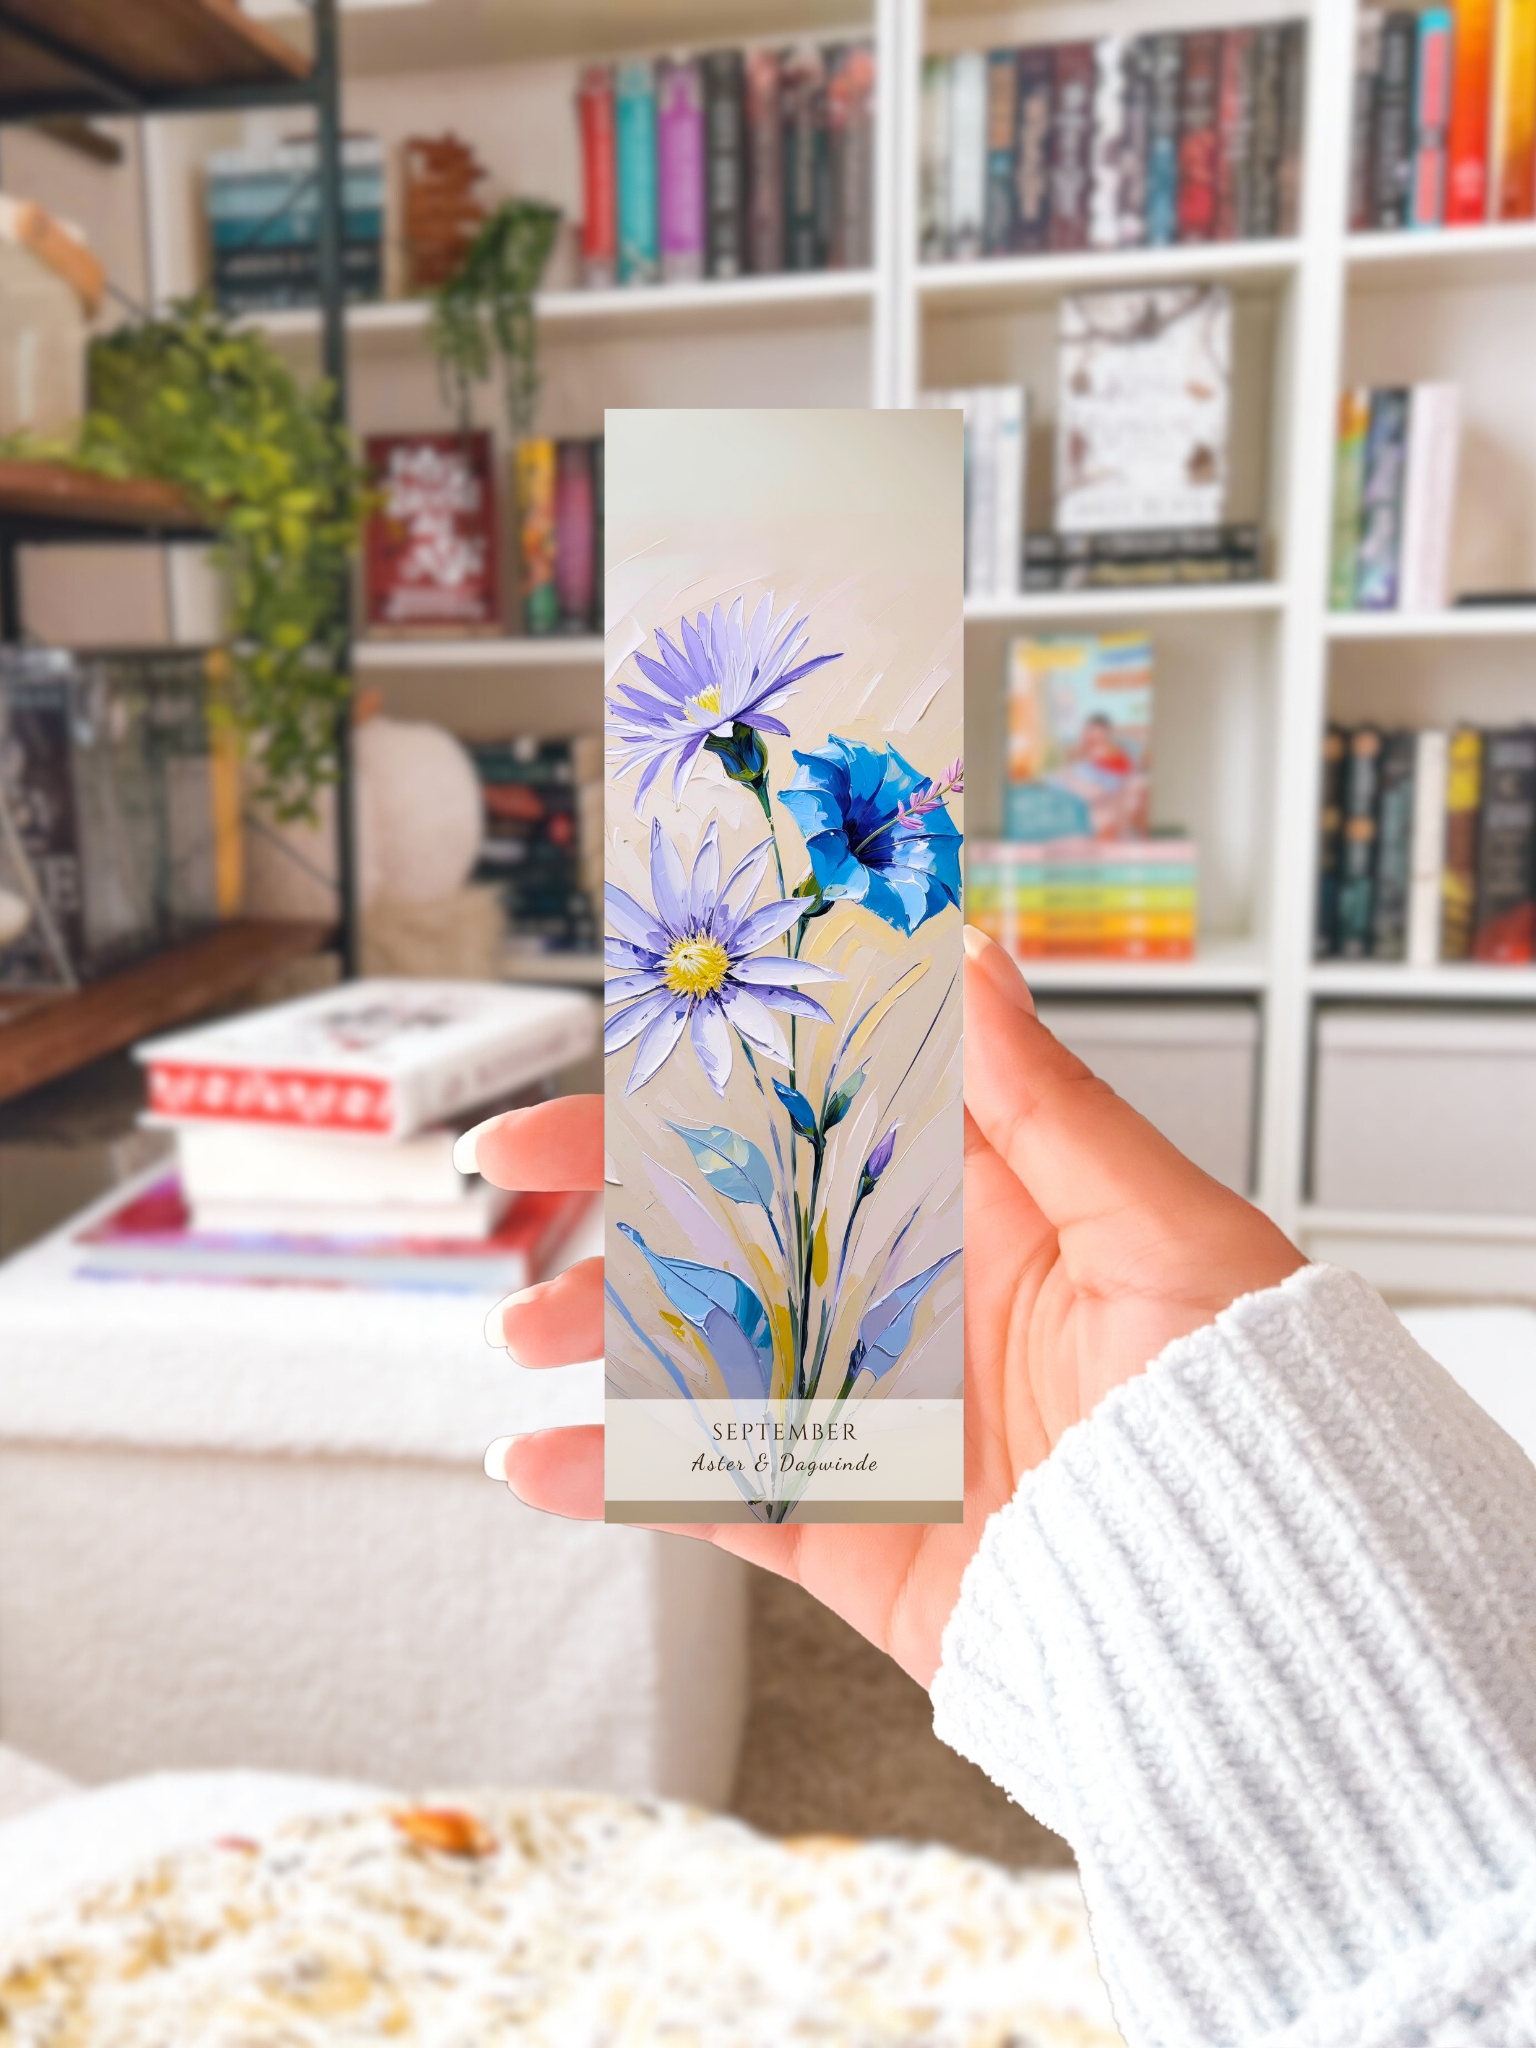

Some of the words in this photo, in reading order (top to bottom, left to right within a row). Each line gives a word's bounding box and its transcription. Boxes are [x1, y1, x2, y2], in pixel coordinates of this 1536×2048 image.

[712, 1422, 858, 1441] SEPTEMBER
[691, 1452, 746, 1473] Aster
[754, 1452, 770, 1473] &
[780, 1452, 879, 1477] Dagwinde
